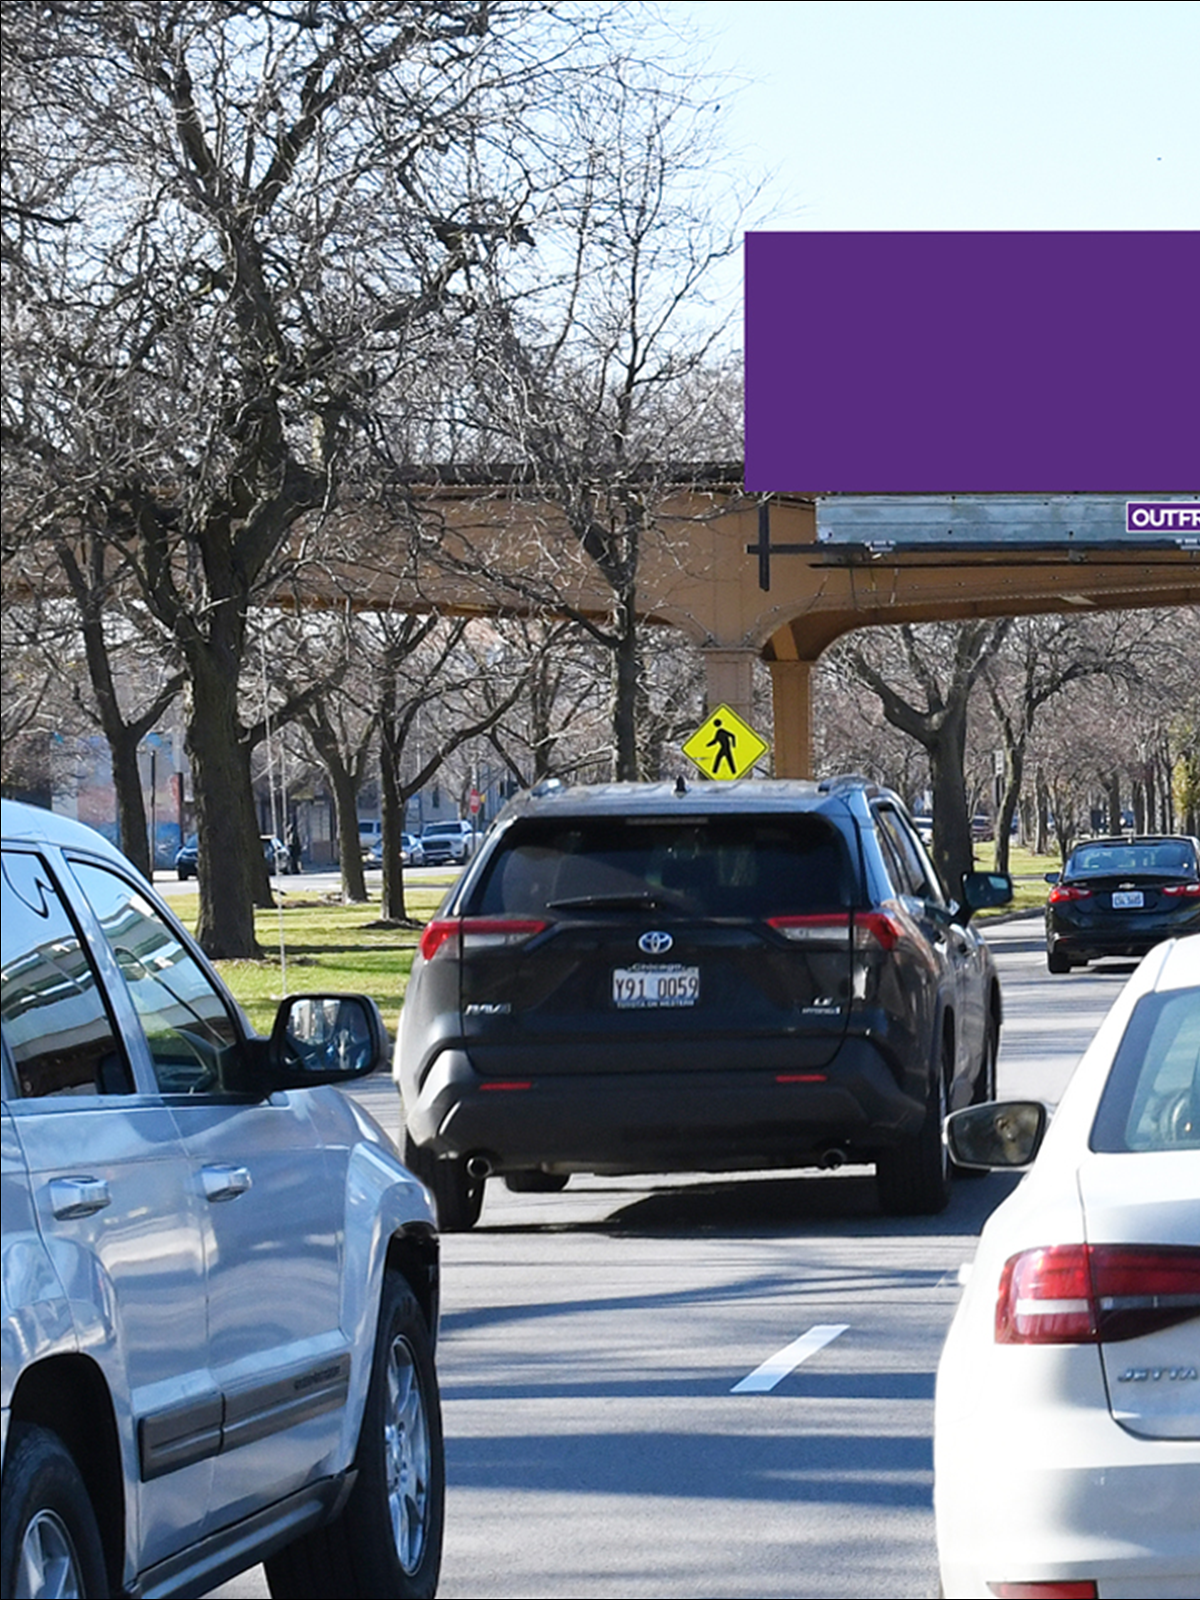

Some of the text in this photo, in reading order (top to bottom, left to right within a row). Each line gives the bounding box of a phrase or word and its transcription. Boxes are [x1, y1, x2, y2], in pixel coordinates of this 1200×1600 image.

[615, 976, 698, 1001] Y91 0059
[1117, 1365, 1199, 1382] JETTA
